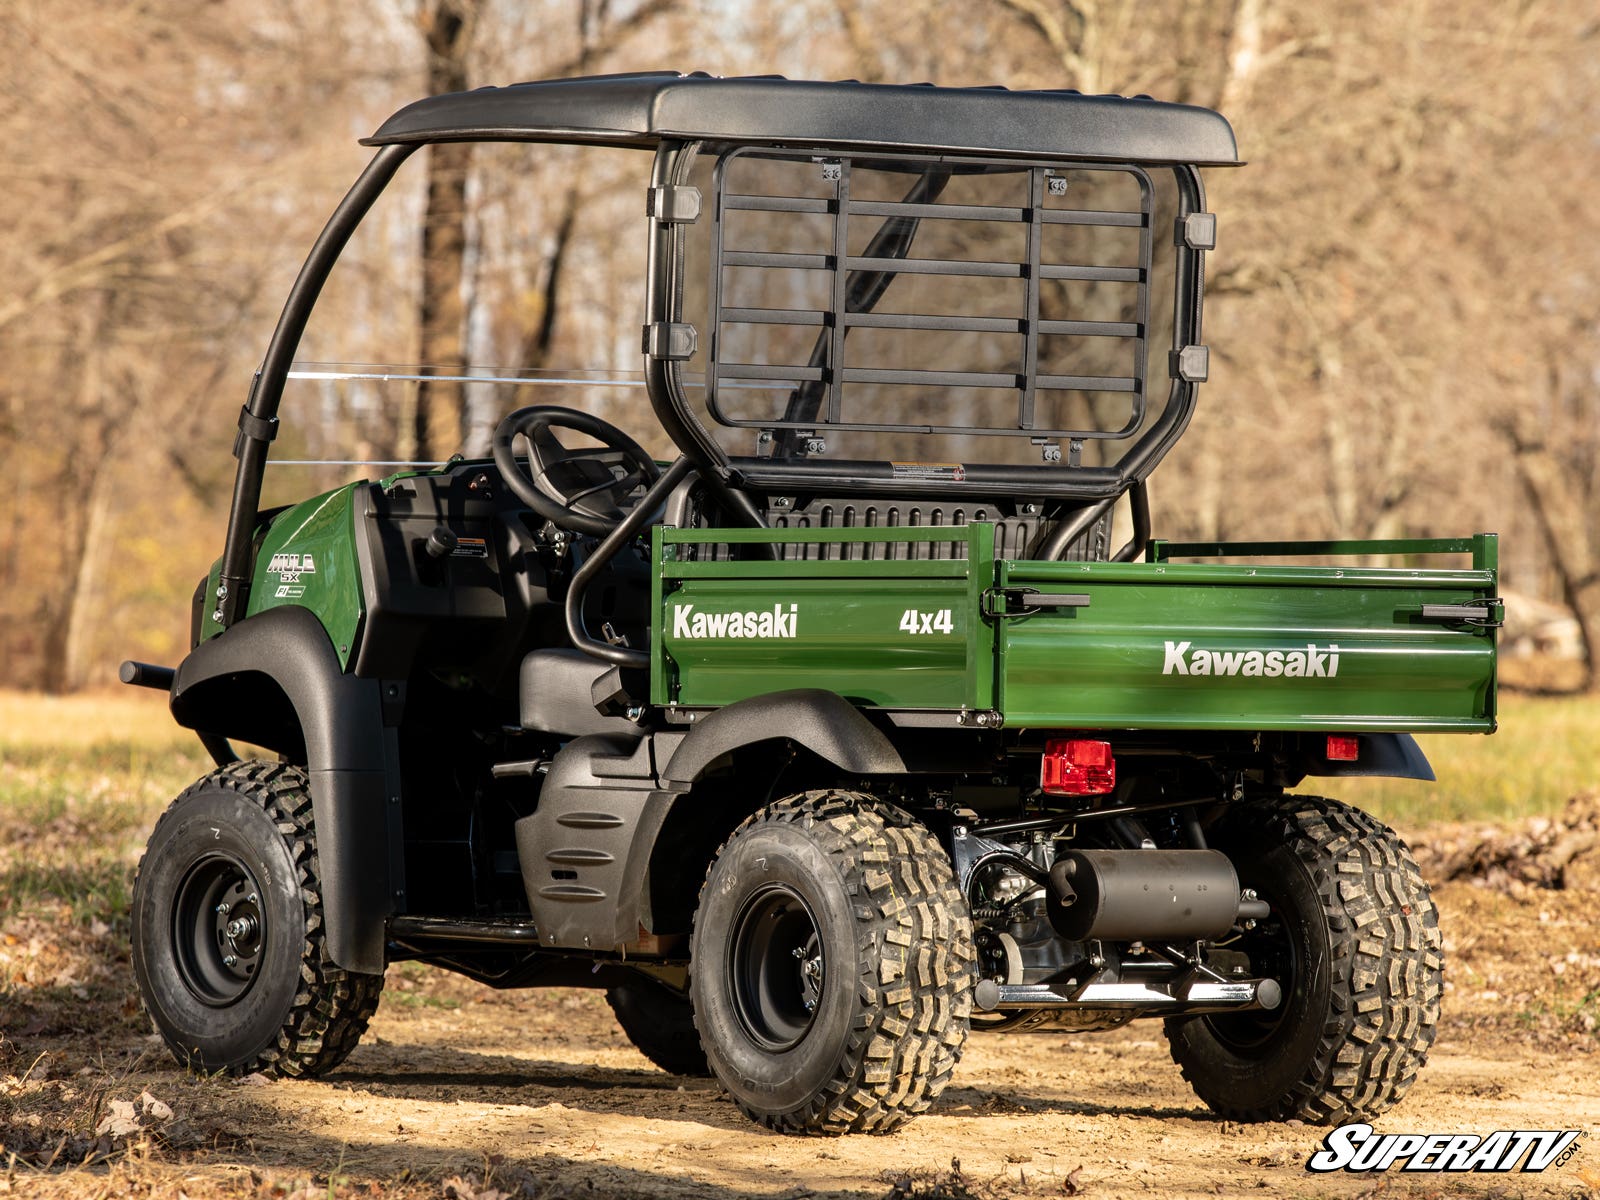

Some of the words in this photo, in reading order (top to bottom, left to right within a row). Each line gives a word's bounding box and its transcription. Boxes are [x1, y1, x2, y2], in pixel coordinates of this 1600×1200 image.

[266, 553, 316, 573] MULE
[281, 572, 300, 582] SX
[673, 603, 798, 639] Kawasaki
[899, 609, 954, 634] 4x4
[1162, 641, 1340, 678] Kawasaki
